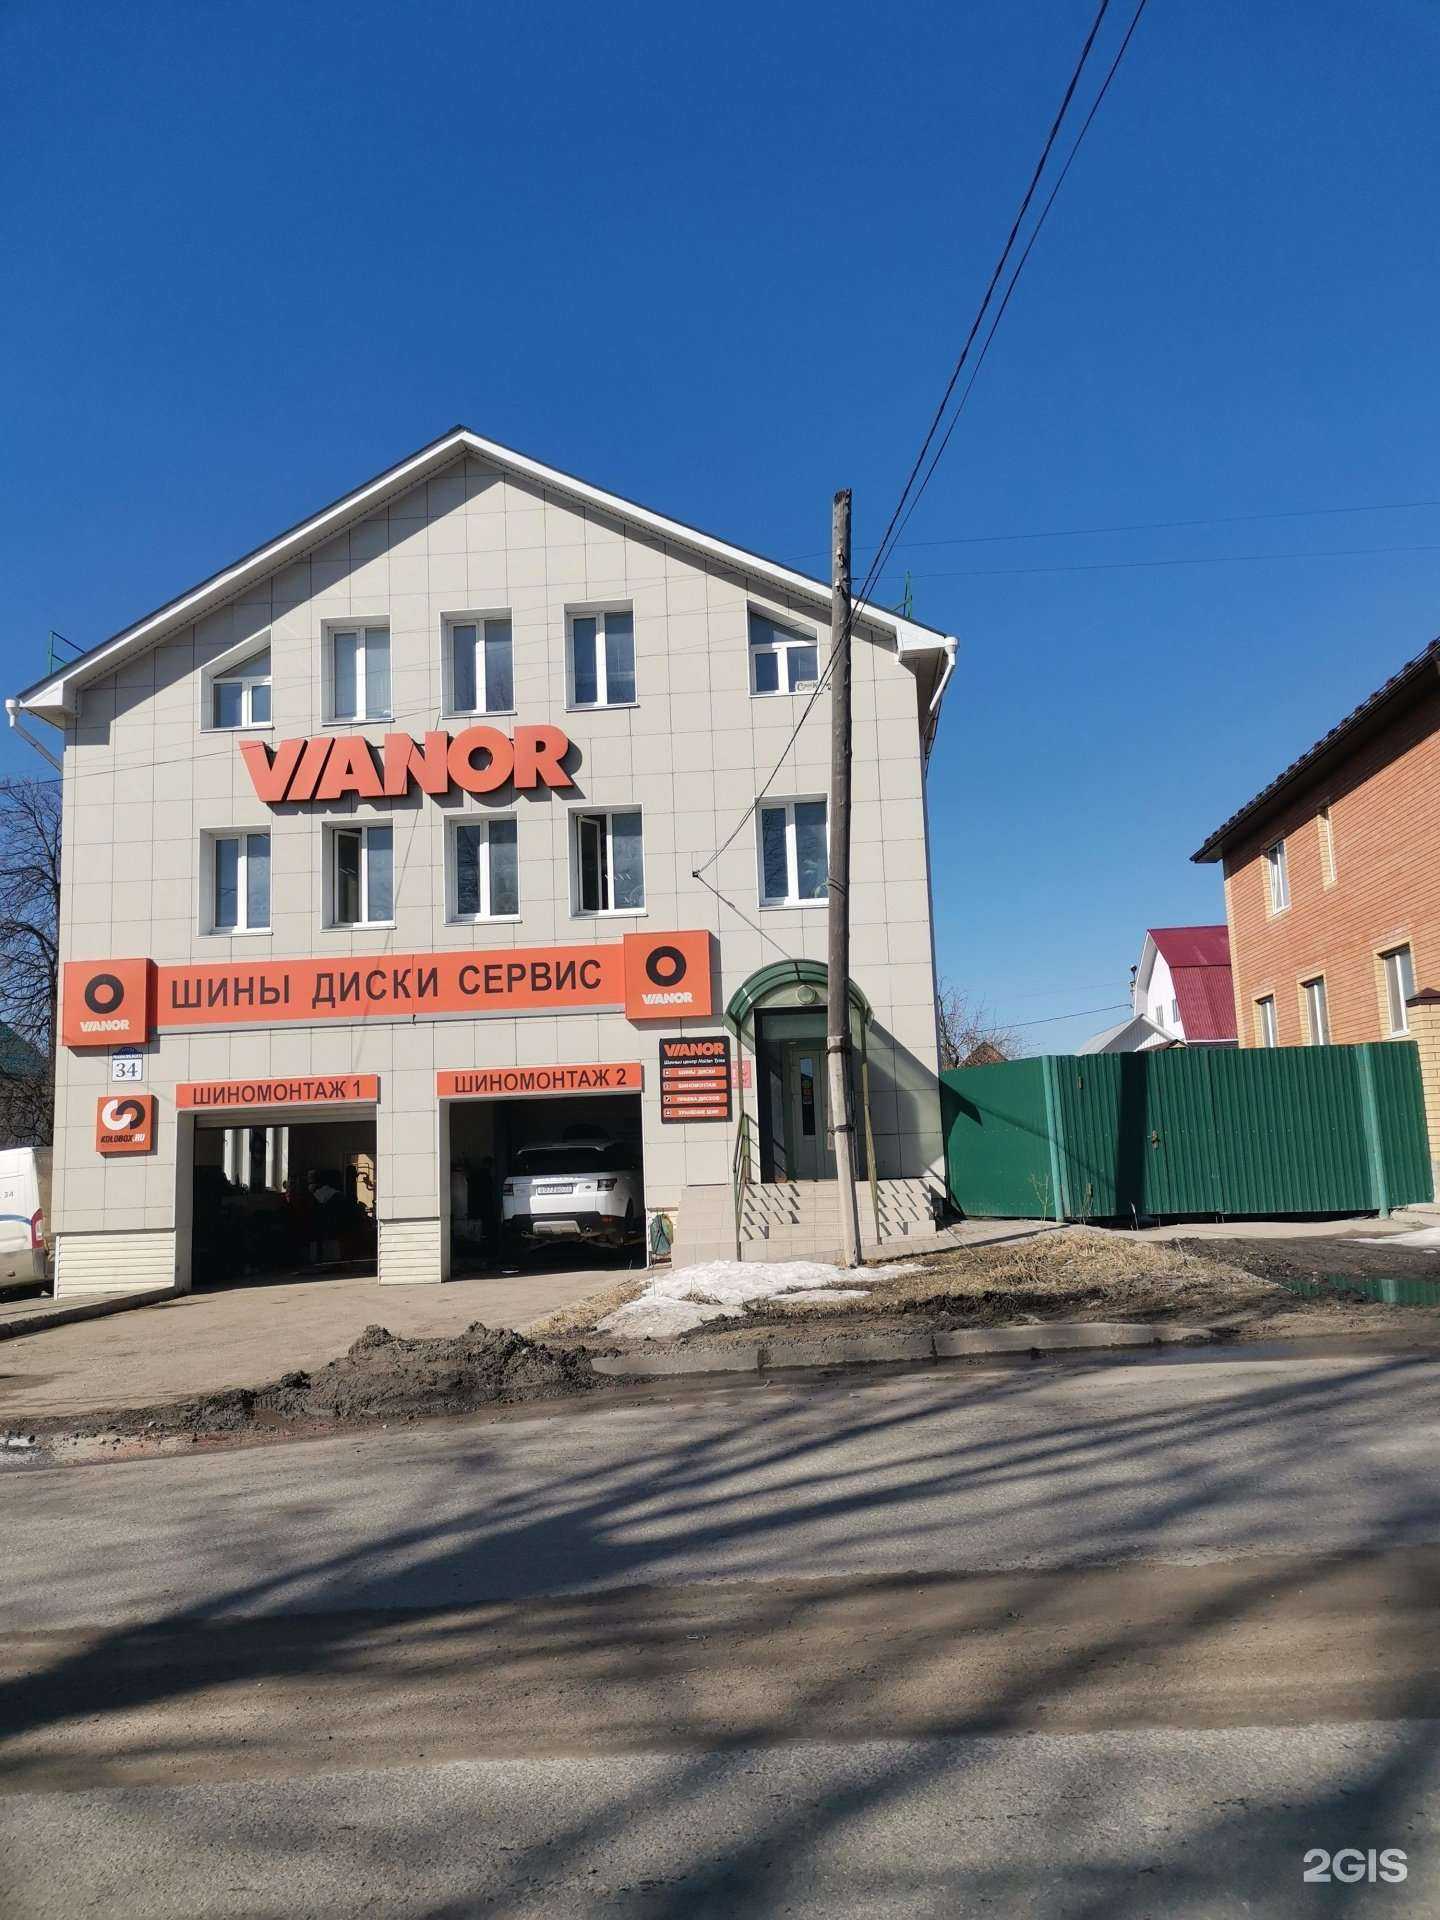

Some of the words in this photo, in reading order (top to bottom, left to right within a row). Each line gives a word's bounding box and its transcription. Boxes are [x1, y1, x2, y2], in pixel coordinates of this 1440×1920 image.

[239, 725, 573, 803] VIANOR
[172, 974, 290, 1008] ШИНЫ
[311, 967, 438, 1009] ДИСКИ
[458, 959, 601, 995] СЕРВИС
[642, 991, 693, 1004] VIANOR
[80, 1019, 130, 1032] VIANOR
[664, 1042, 725, 1056] VIANOR
[115, 1062, 138, 1078] 34
[455, 1069, 610, 1093] ШИНОМОНТАЖ
[616, 1068, 627, 1085] 2
[193, 1081, 346, 1105] ШИНОМОНТАЖ
[353, 1080, 360, 1096] 1
